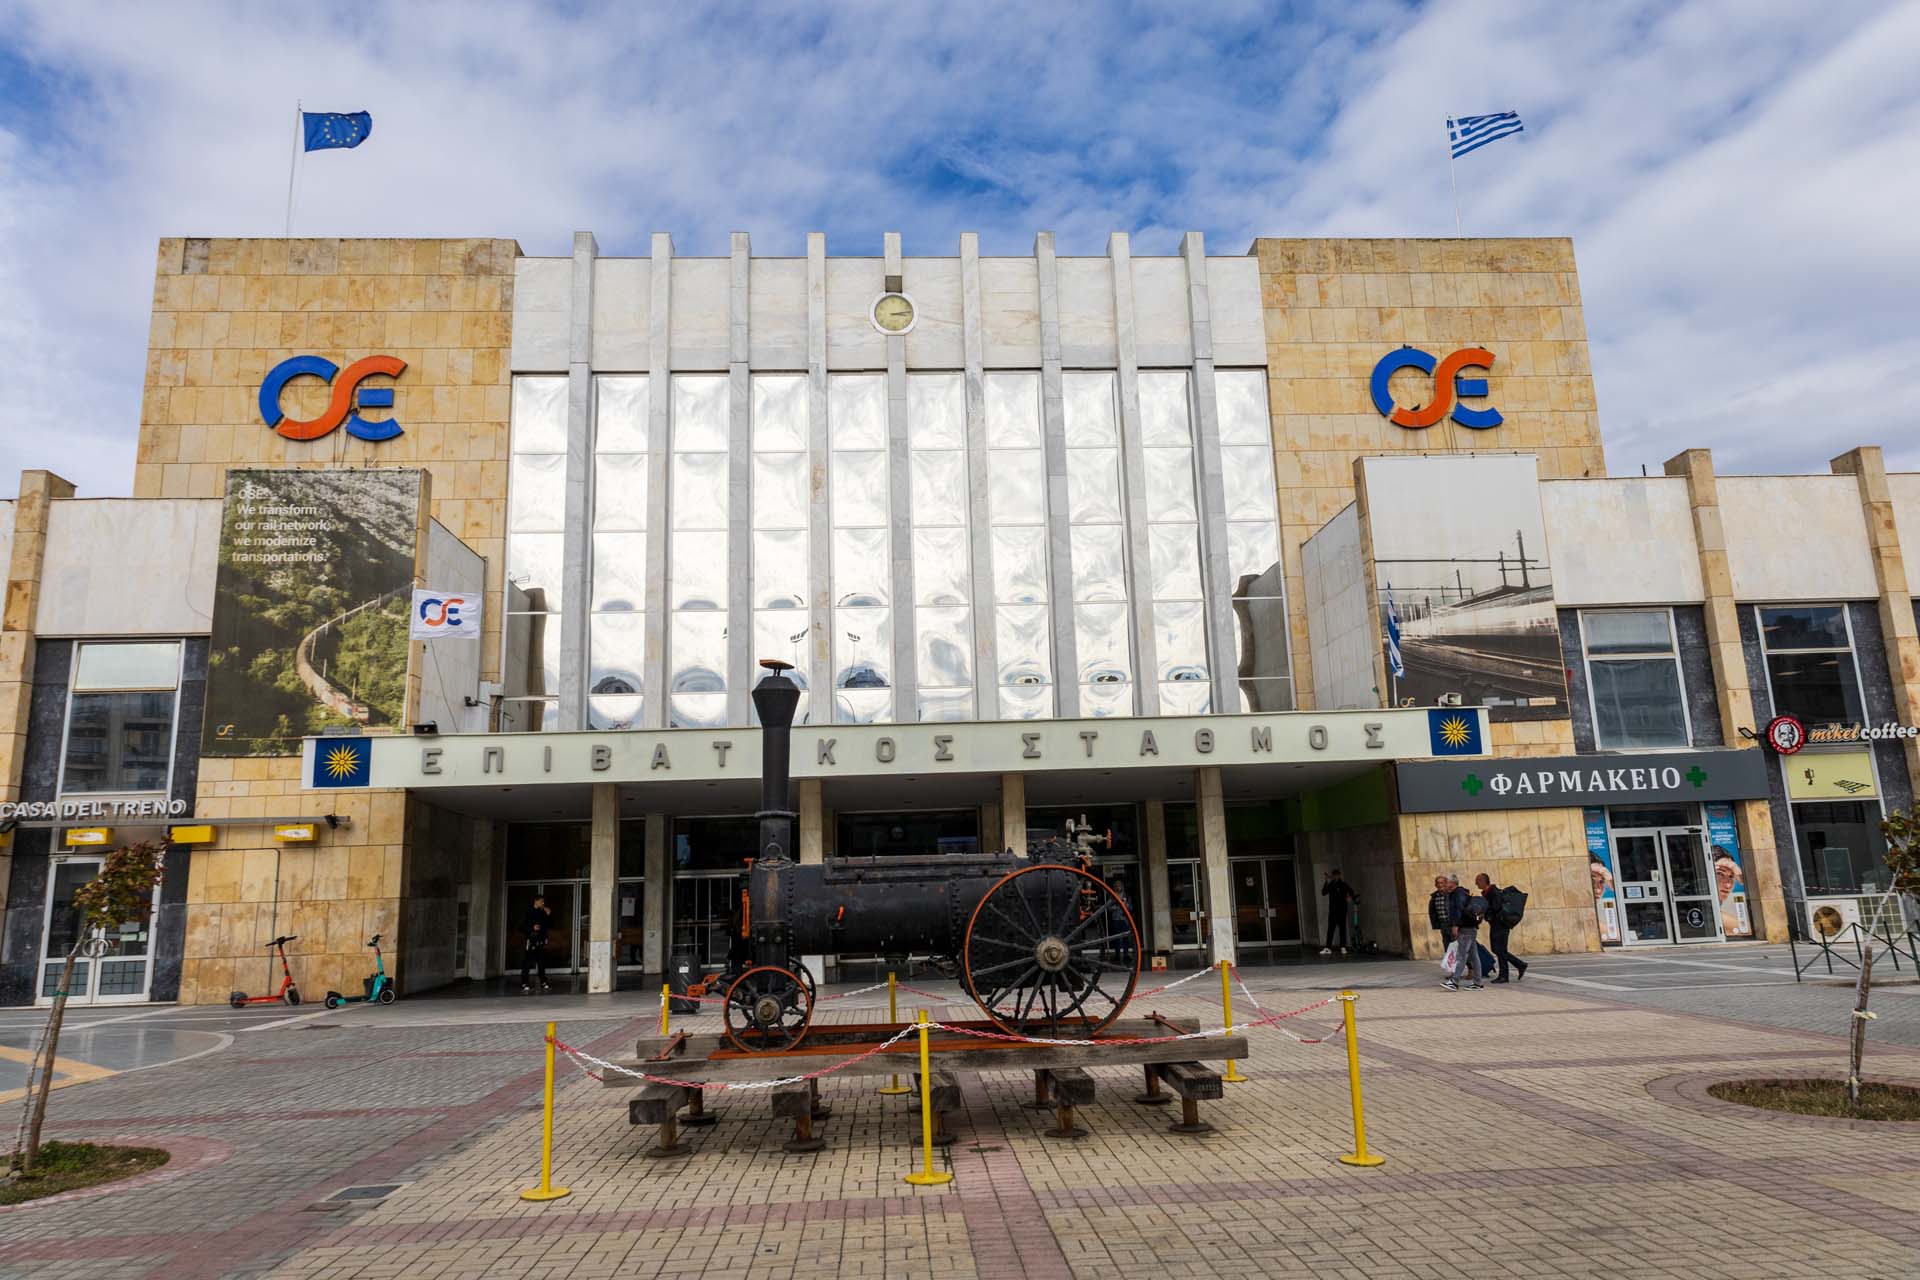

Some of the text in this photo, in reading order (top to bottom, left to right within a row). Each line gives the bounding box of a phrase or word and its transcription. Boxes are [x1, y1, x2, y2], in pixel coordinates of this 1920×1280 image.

[236, 503, 317, 515] We transform
[234, 522, 255, 530] our
[257, 519, 277, 531] rail
[233, 535, 317, 546] we modernize
[1808, 722, 1861, 743] mikel
[1860, 722, 1919, 740] coffee
[422, 722, 1386, 775] ΕΠΙΒΑΤΚΟΣ ΣΤΑΘΜΟΣ
[1489, 766, 1682, 796] ΦΑΡΜΑΚΕΙΟ
[0, 798, 188, 818] CASA DEL TRENO
